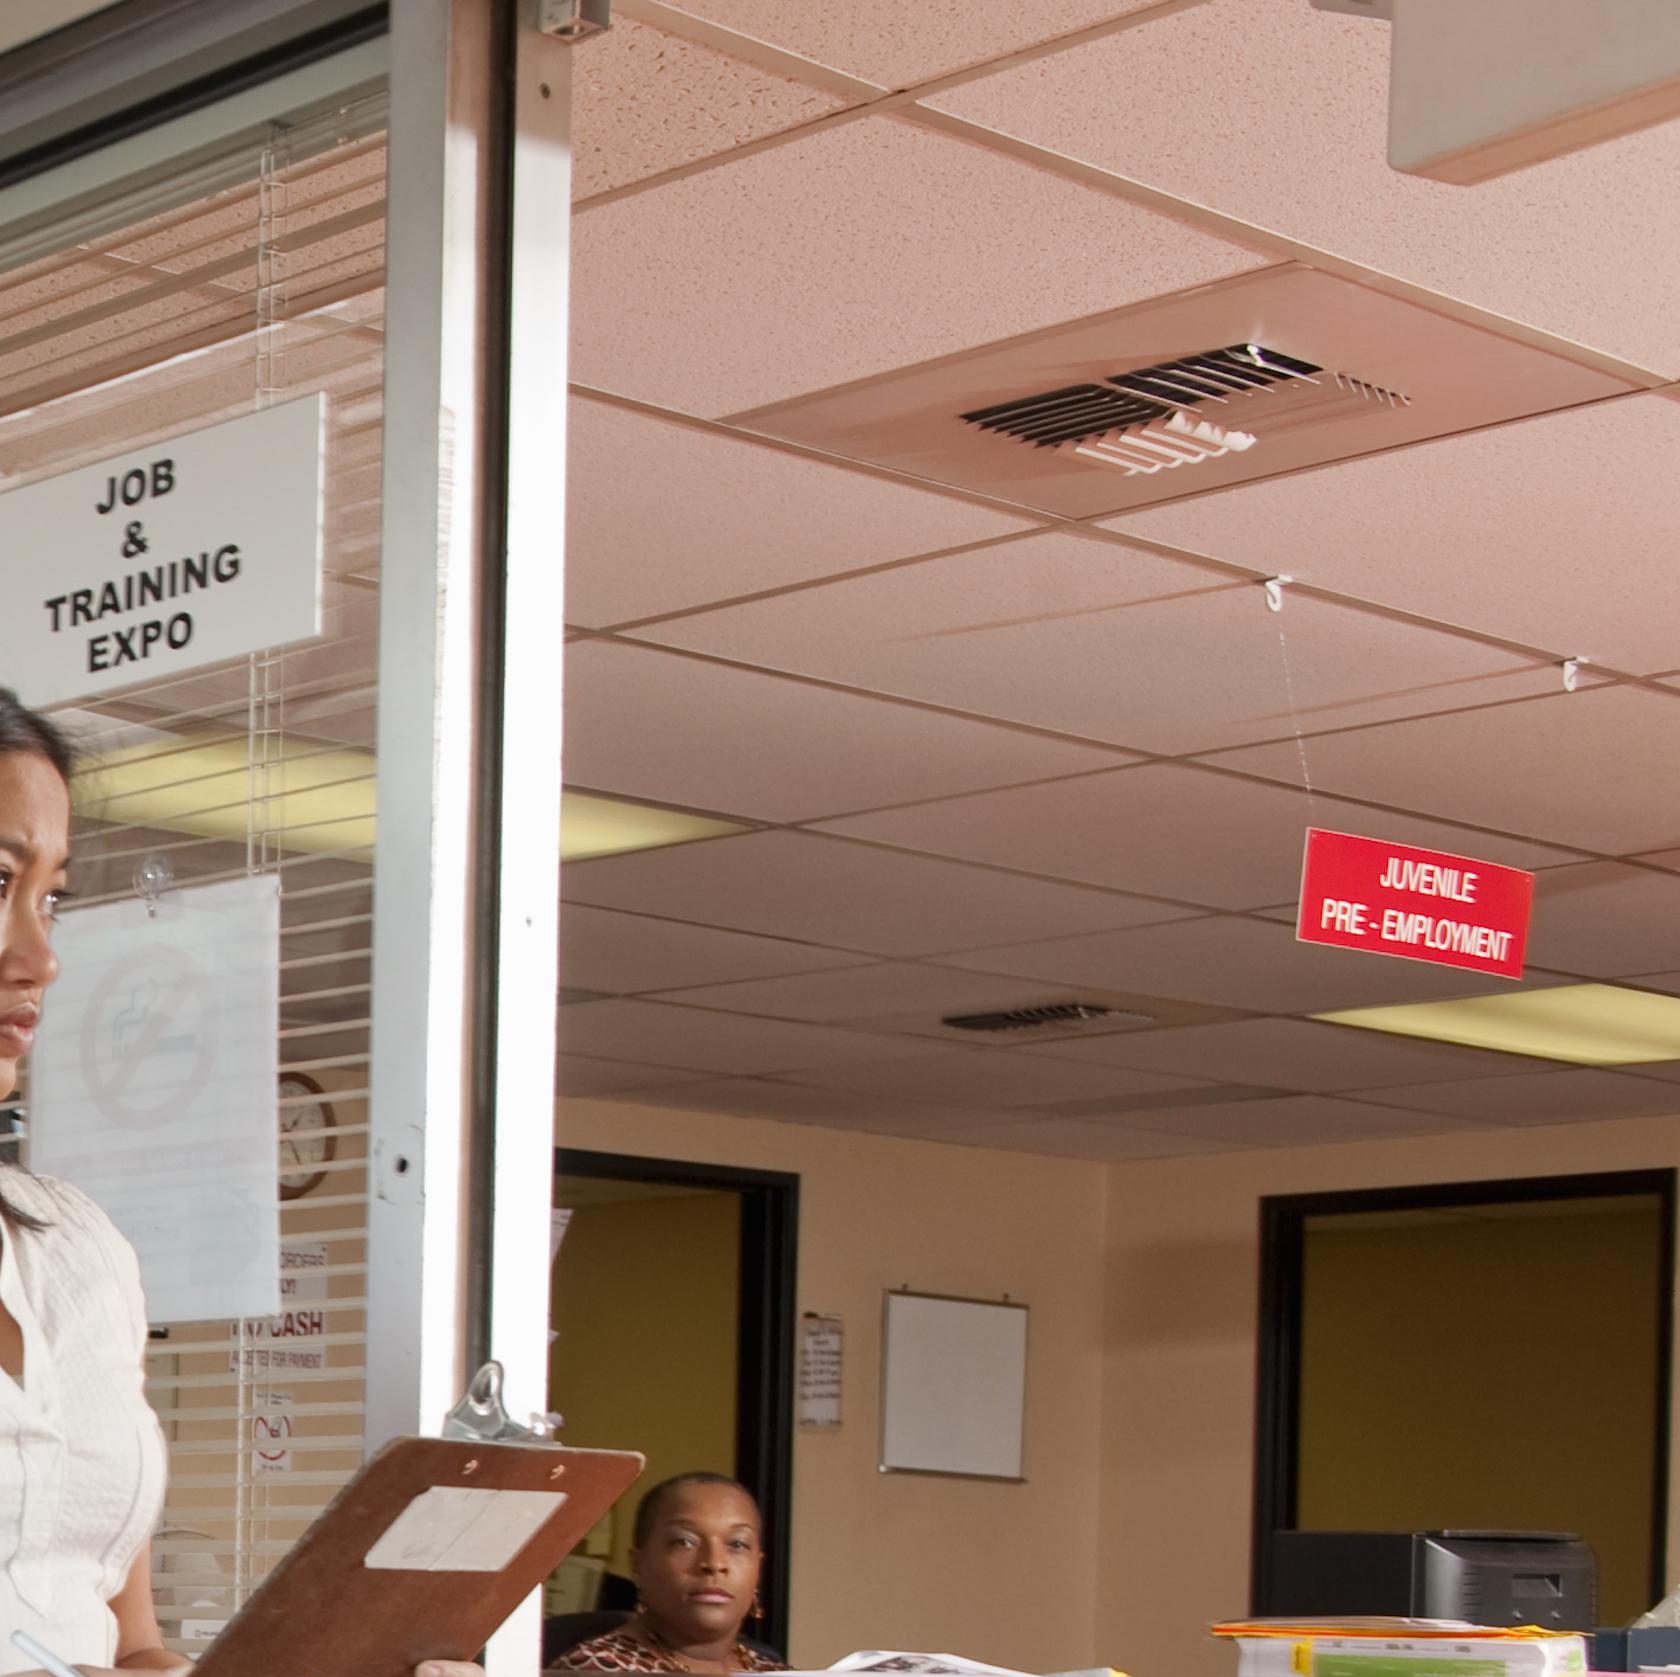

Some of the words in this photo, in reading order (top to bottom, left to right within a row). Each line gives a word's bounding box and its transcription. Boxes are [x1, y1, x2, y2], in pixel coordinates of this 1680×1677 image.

[95, 457, 176, 516] JOB
[120, 520, 149, 560] &
[44, 543, 241, 633] TRAINING
[87, 611, 194, 674] EXPO
[1379, 857, 1479, 904] JUVENILE
[270, 1311, 323, 1337] CASH
